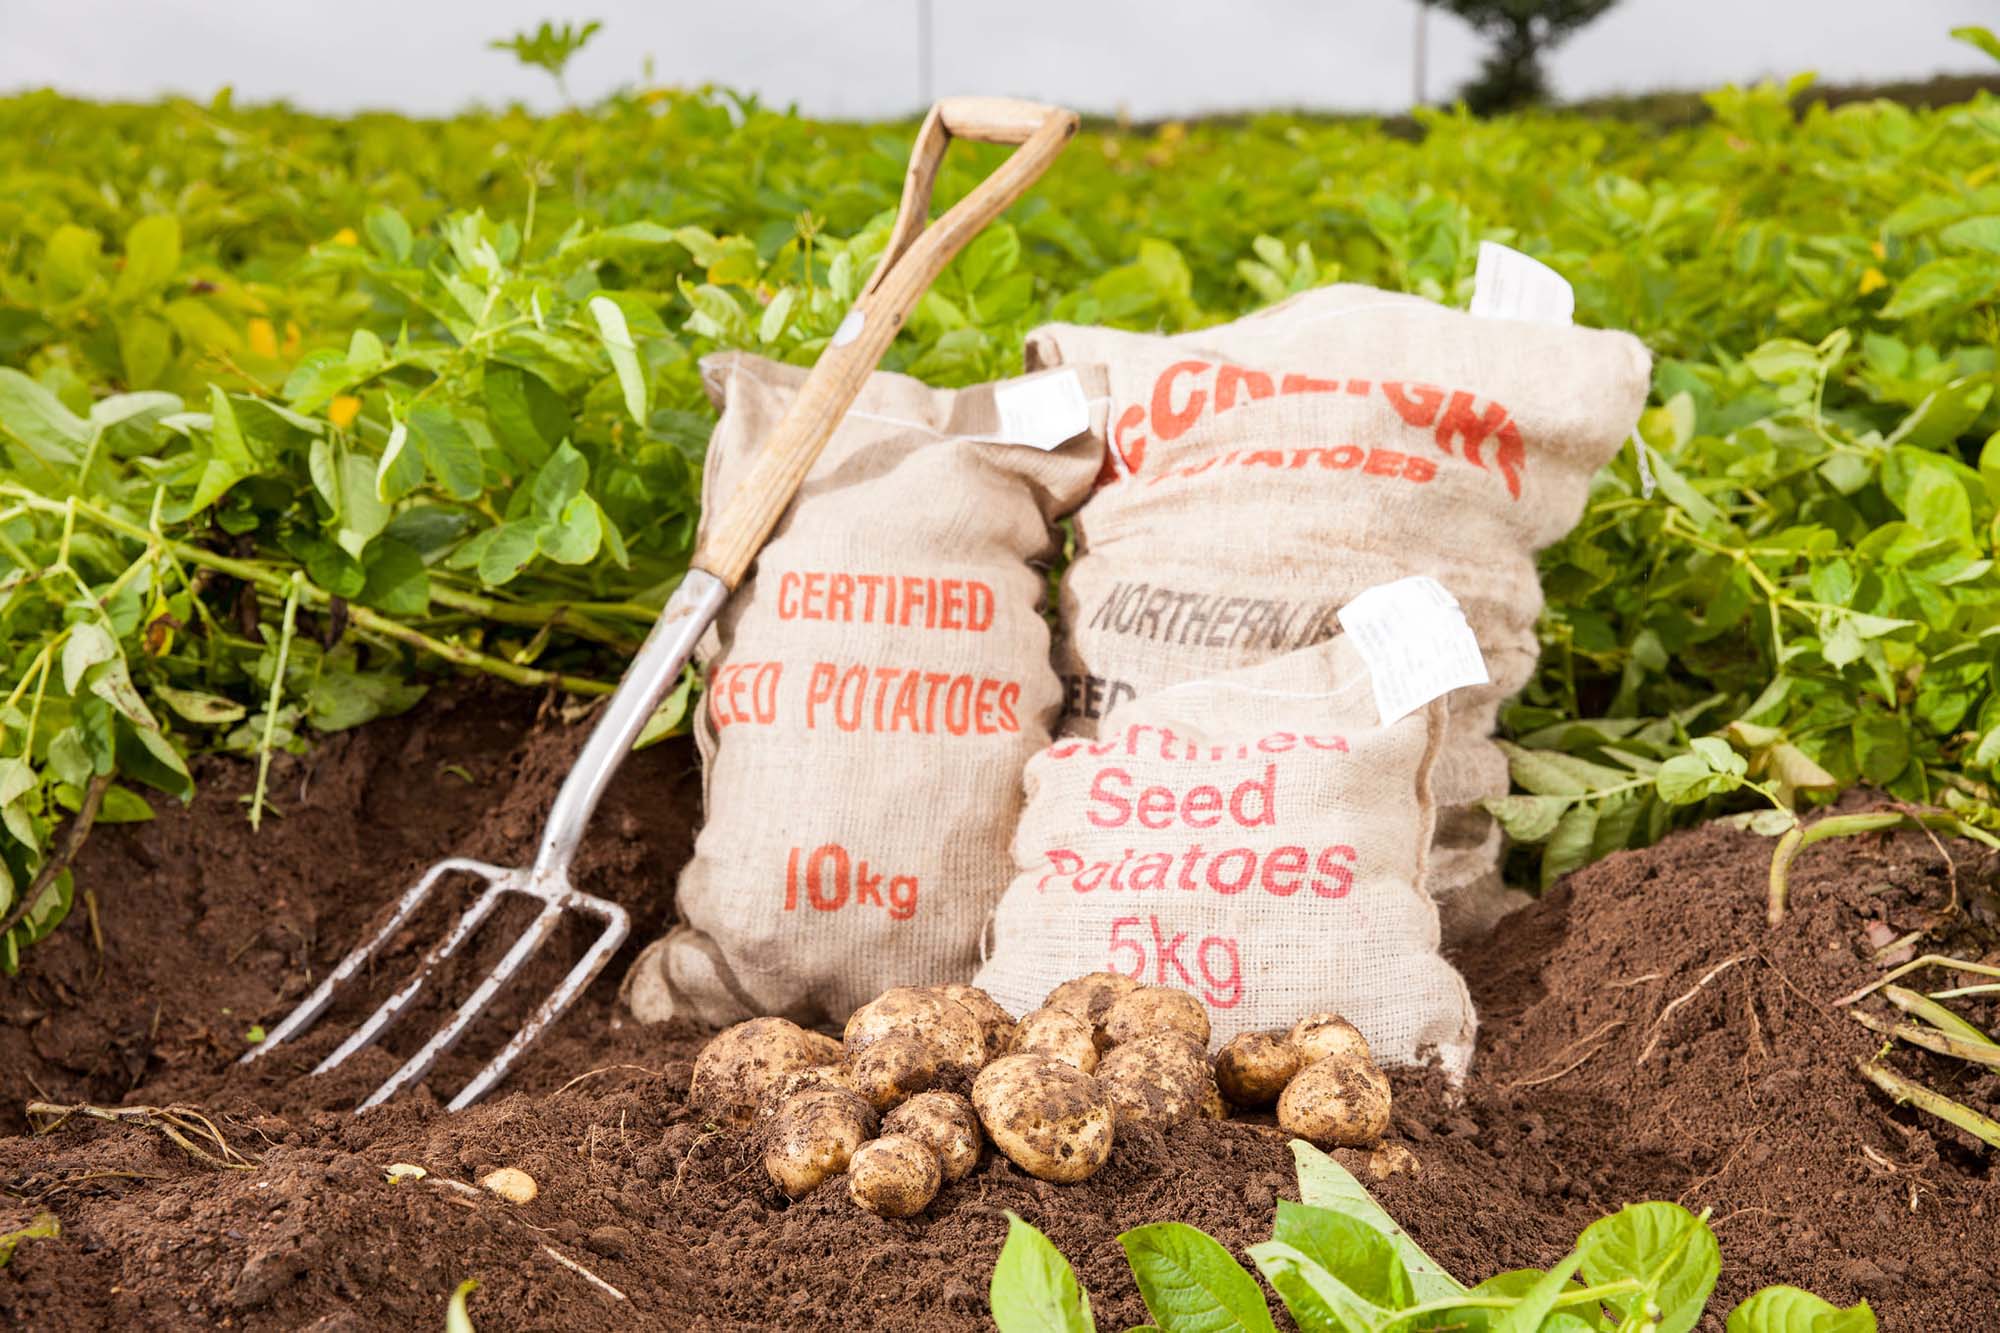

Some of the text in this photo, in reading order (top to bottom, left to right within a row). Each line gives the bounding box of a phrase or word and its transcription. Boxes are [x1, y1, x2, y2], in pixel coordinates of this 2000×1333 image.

[778, 571, 995, 632] CERTIFIED
[1089, 581, 1305, 649] NORTHERN
[709, 661, 1021, 736] EED POTATOES
[1086, 763, 1277, 829] Seed
[784, 843, 919, 920] 10kg
[1107, 913, 1243, 1009] 5kg
